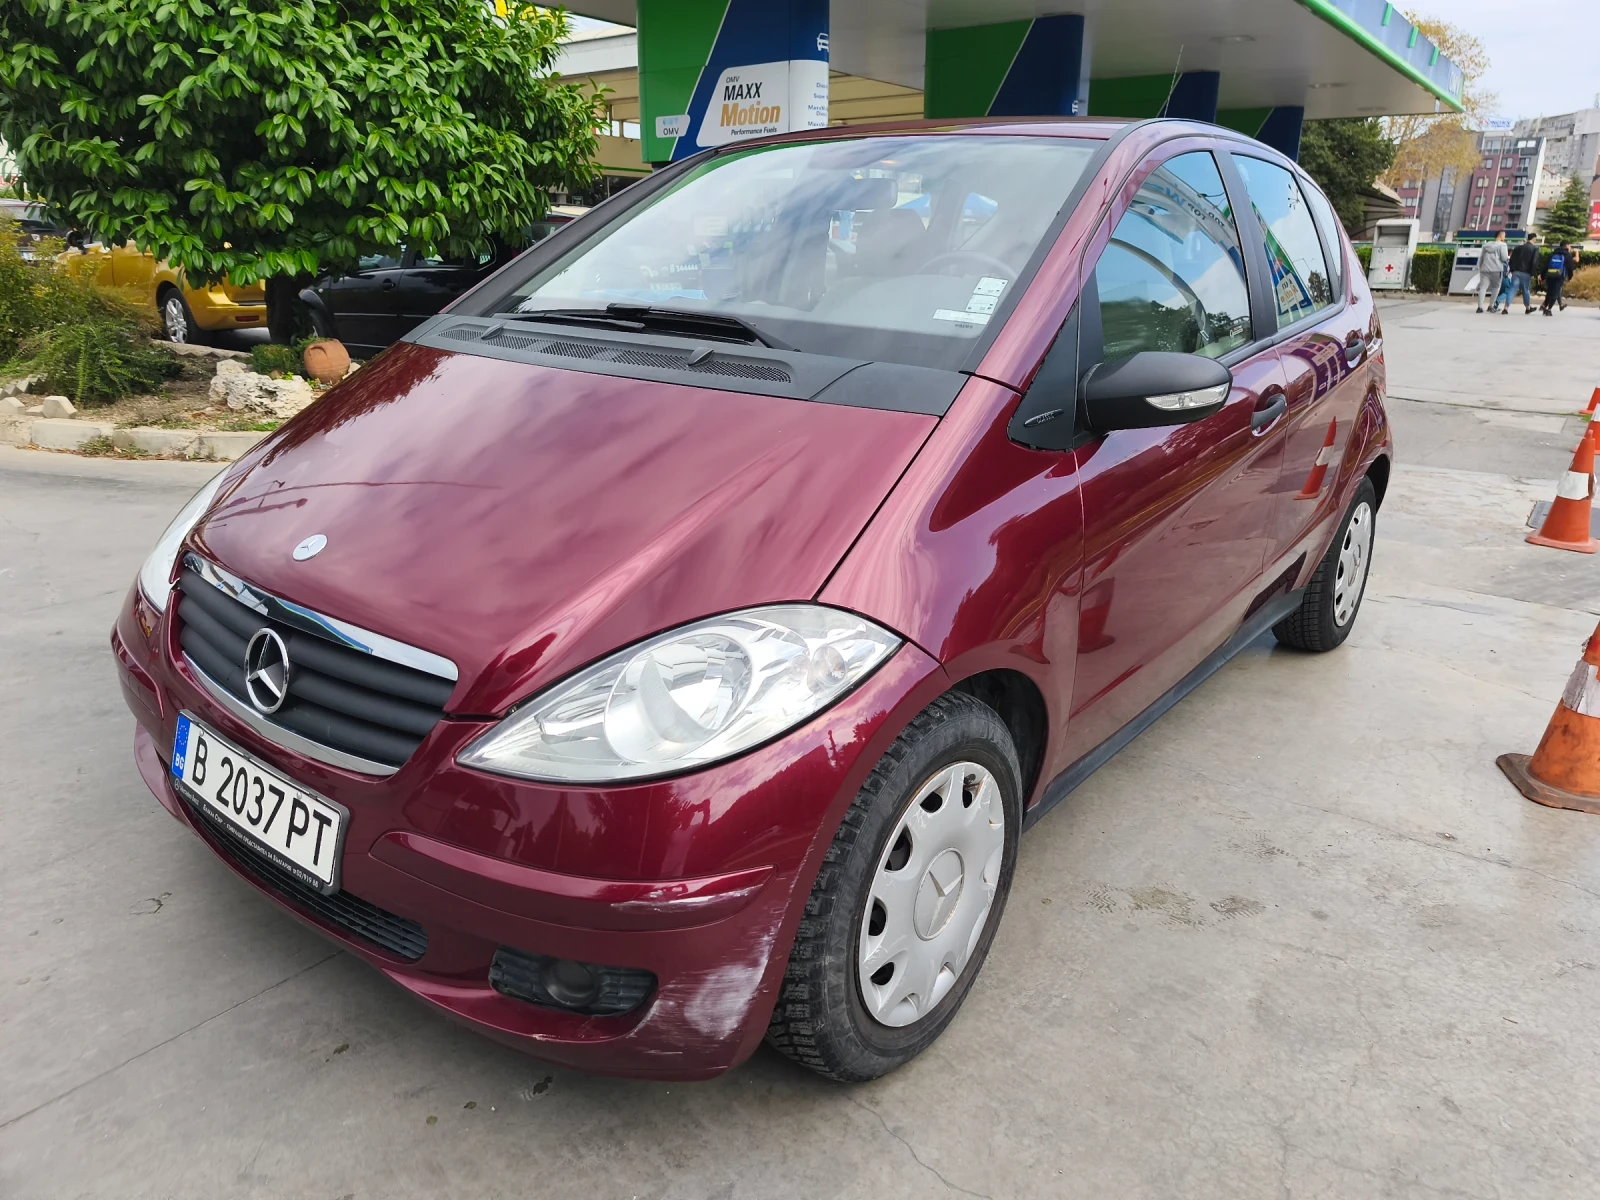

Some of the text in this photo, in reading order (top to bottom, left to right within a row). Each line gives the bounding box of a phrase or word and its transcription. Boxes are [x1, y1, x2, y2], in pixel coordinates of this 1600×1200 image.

[723, 82, 762, 101] MAXX
[720, 101, 781, 127] Motion
[663, 127, 680, 136] OMV
[730, 126, 778, 136] Performance Fuels
[174, 753, 186, 771] BG
[192, 736, 333, 867] B 2037 PT
